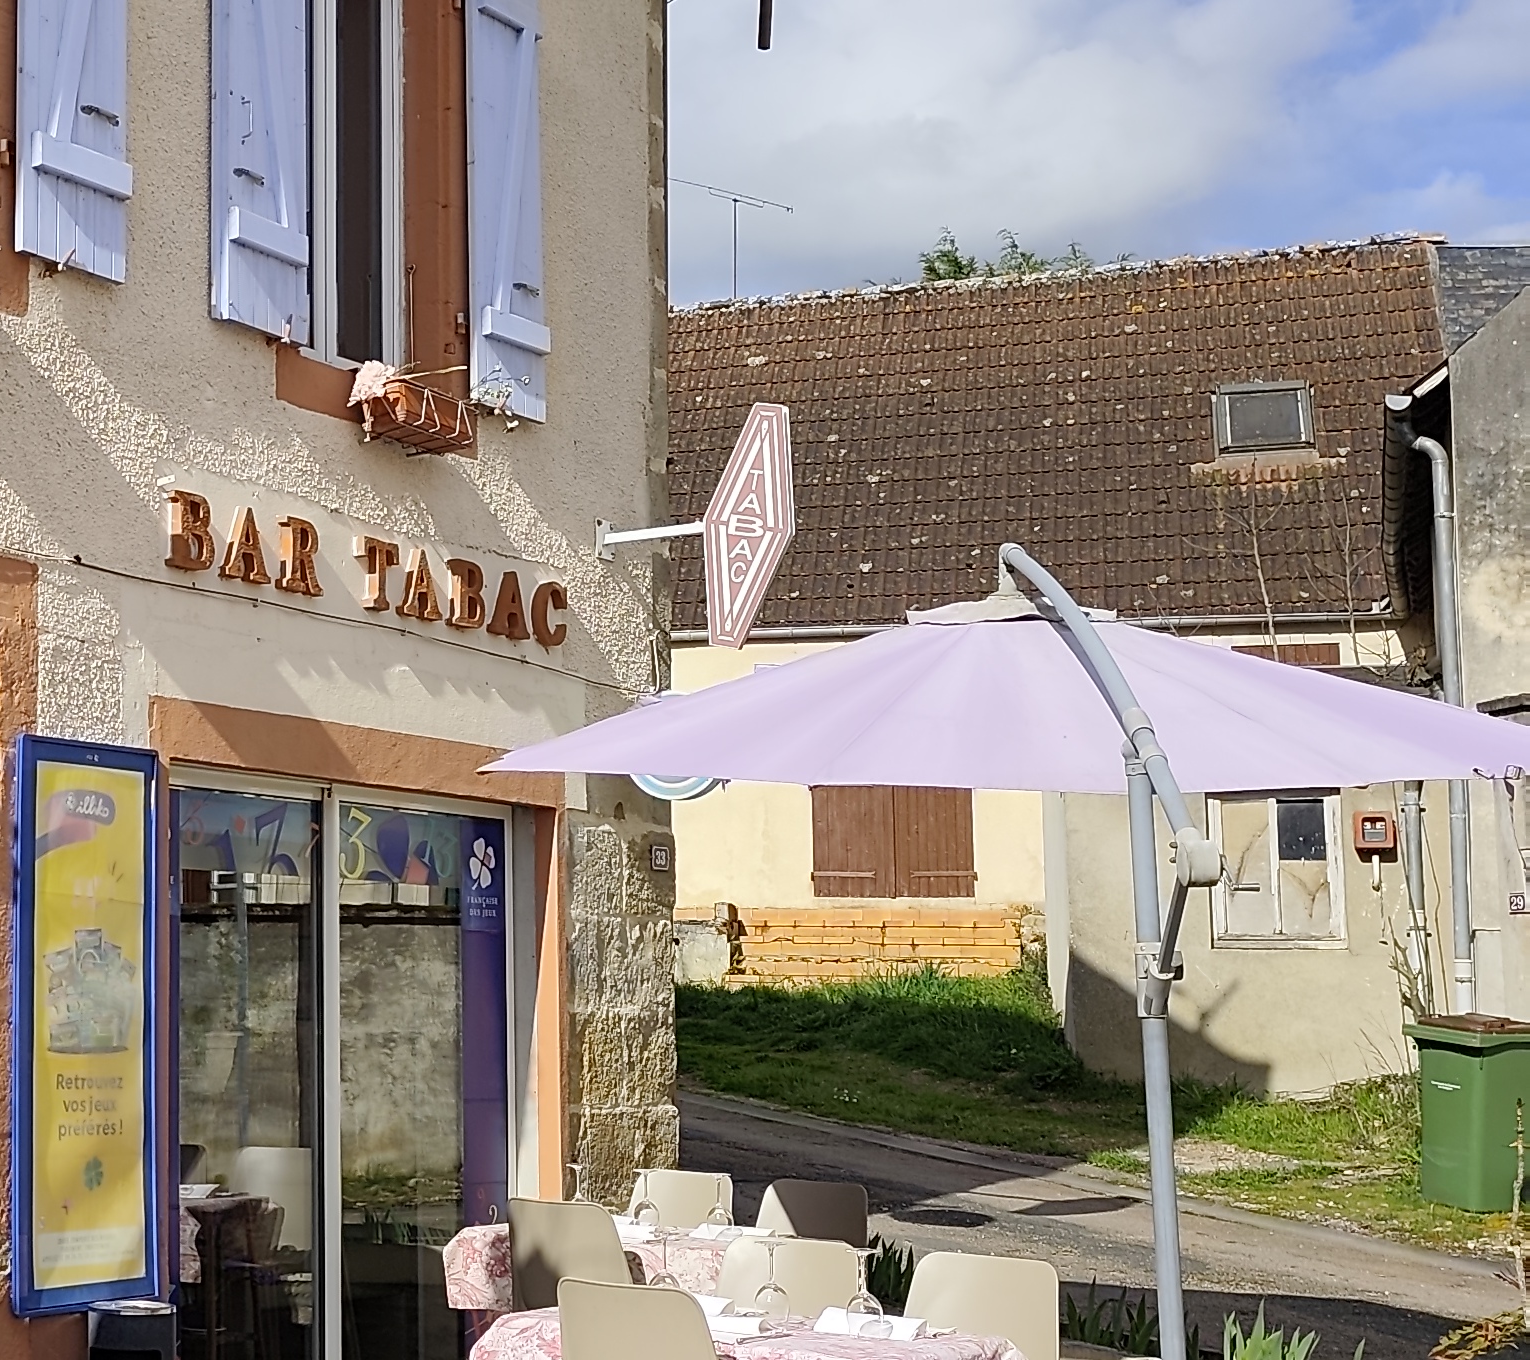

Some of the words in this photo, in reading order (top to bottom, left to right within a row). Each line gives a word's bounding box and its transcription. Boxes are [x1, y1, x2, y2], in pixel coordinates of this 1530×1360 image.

[728, 469, 764, 584] TABAC
[164, 489, 324, 598] BAR
[352, 534, 568, 648] TABAC
[339, 807, 373, 880] 3
[655, 850, 666, 866] 33
[1510, 896, 1525, 910] 29
[56, 1073, 123, 1090] Retrouvez
[62, 1098, 86, 1113] vos
[88, 1096, 117, 1116] jeux
[58, 1118, 117, 1141] préférés
